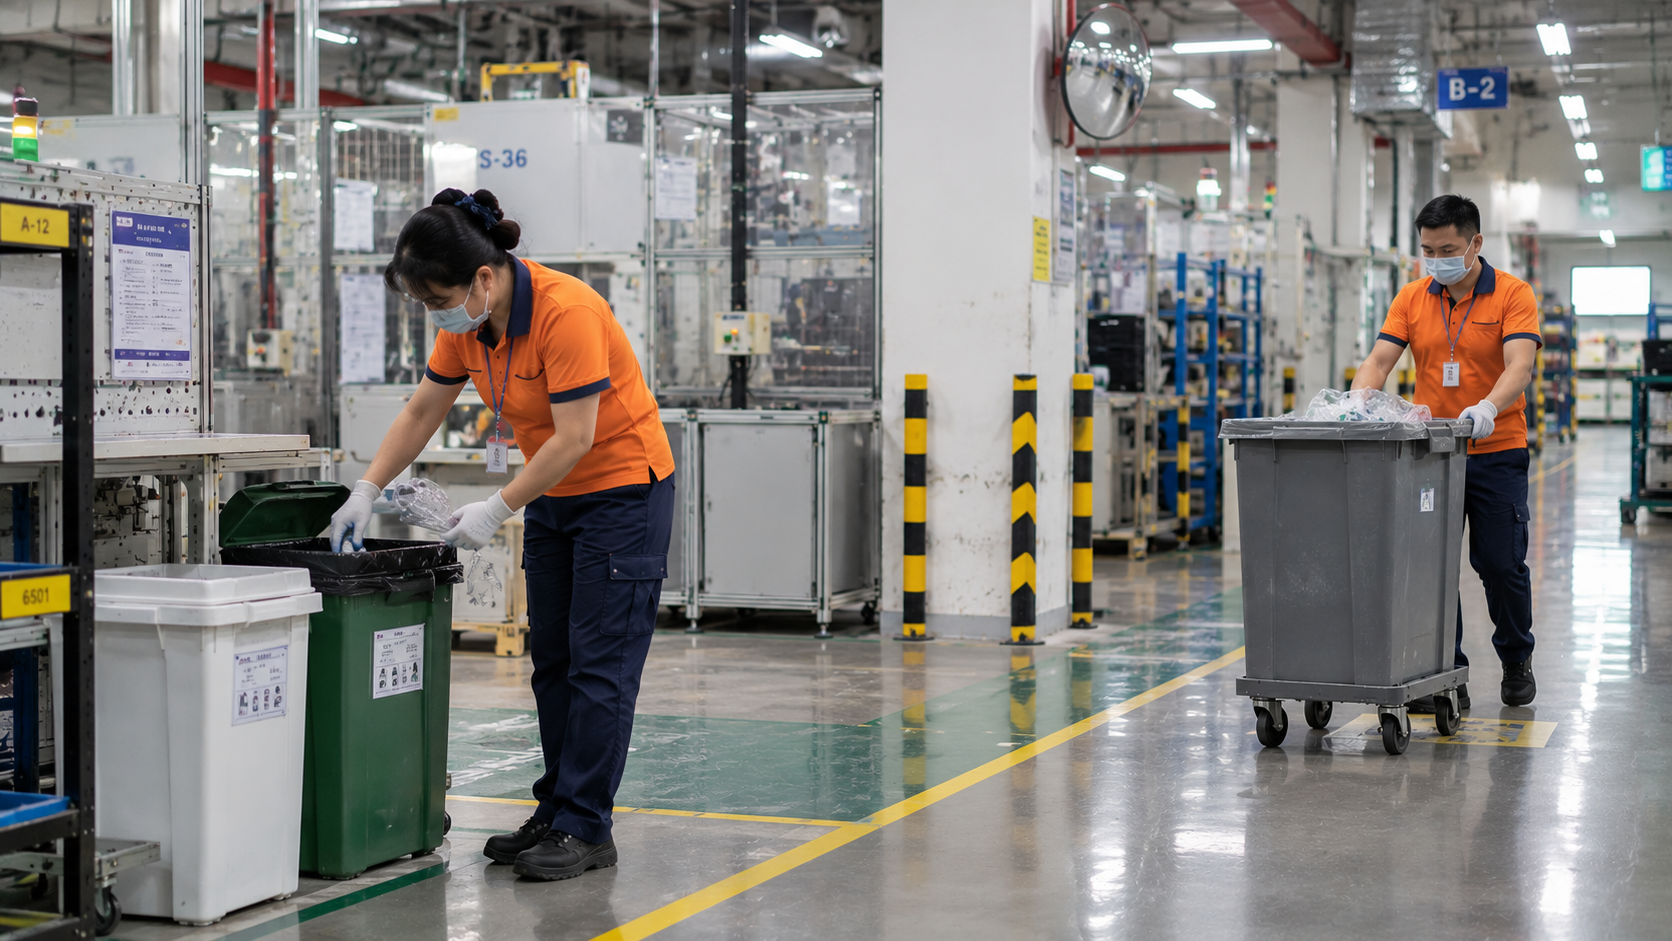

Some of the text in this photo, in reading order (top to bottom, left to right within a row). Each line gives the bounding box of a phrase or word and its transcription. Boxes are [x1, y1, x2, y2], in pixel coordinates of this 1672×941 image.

[1449, 76, 1496, 101] B-2
[479, 149, 528, 169] S-36
[21, 216, 50, 234] A-12
[22, 587, 49, 606] 6501
